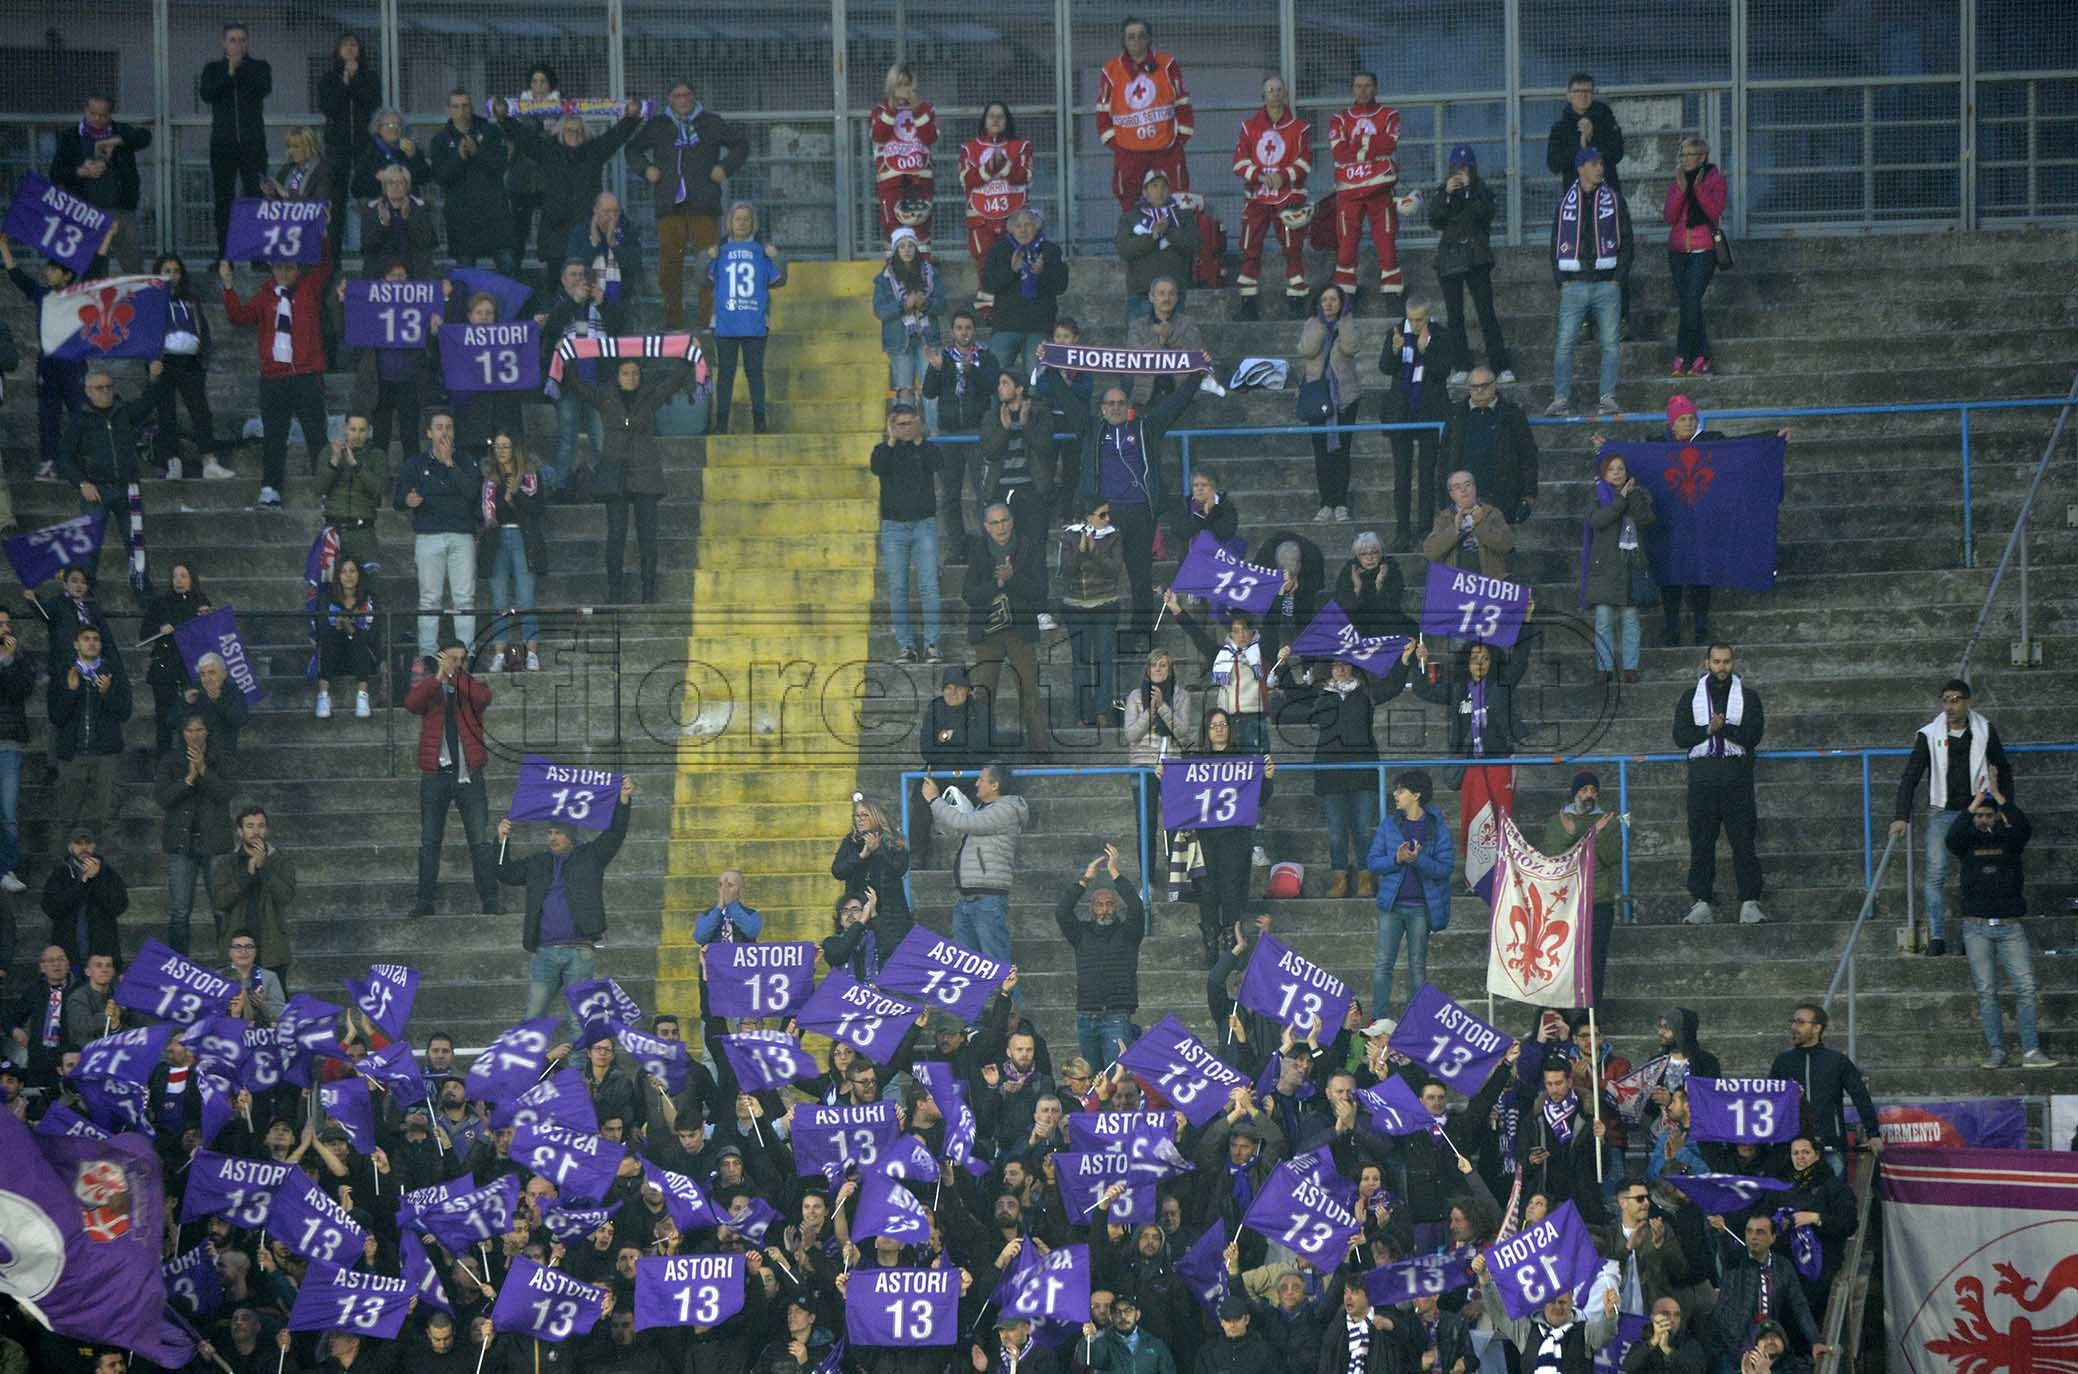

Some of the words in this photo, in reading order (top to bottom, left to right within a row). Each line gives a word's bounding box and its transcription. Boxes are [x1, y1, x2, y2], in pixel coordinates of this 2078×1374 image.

[42, 186, 105, 230] ASTORI
[257, 201, 322, 222] ASTORI
[41, 215, 83, 258] 13
[264, 226, 302, 257] 13
[369, 284, 434, 304] ASTORI
[725, 262, 756, 298] 13
[378, 310, 421, 344] 13
[464, 326, 528, 347] ASTORI
[475, 351, 519, 385] 13
[1067, 349, 1191, 370] FIORENTINA
[1214, 571, 1258, 602] 13
[1452, 573, 1520, 602] ASTORI
[1458, 601, 1502, 637] 13
[219, 632, 257, 694] ASTORI
[546, 765, 611, 786] ASTORI
[1185, 761, 1254, 784] ASTORI
[552, 788, 594, 819] 13
[1195, 788, 1237, 823] 13
[733, 946, 803, 967] ASTORI
[928, 940, 1000, 981] ASTORI
[1278, 950, 1344, 998] ASTORI
[160, 956, 230, 998] ASTORI
[744, 974, 790, 1011] 13
[921, 969, 971, 1005] 13
[155, 985, 201, 1024] 13
[842, 985, 912, 1016] ASTORI
[1279, 983, 1322, 1030] 13
[835, 1013, 883, 1047] 13
[1434, 1003, 1501, 1054] ASTORI
[752, 1046, 797, 1083] 13
[1174, 1038, 1240, 1086] ASTORI
[1426, 1034, 1473, 1078] 13
[1158, 1063, 1208, 1104] 13
[1714, 1079, 1786, 1092] ASTORI
[815, 1104, 886, 1125] ASTORI
[1727, 1099, 1774, 1137] 13
[830, 1130, 877, 1165] 13
[1079, 1154, 1128, 1176] ASTO
[225, 1189, 272, 1225] 13
[304, 1187, 361, 1236] ASTORI
[1292, 1178, 1356, 1228] ASTORI
[299, 1218, 343, 1261] 13
[1283, 1214, 1332, 1252] 13
[333, 1268, 407, 1292] ASTORI
[529, 1268, 600, 1301] ASTORI
[664, 1257, 733, 1281] ASTORI
[875, 1272, 948, 1293] ASTORI
[1397, 1266, 1445, 1294] 13
[336, 1294, 385, 1328] 13
[532, 1299, 577, 1337] 13
[674, 1286, 719, 1322] 13
[885, 1300, 932, 1339] 13
